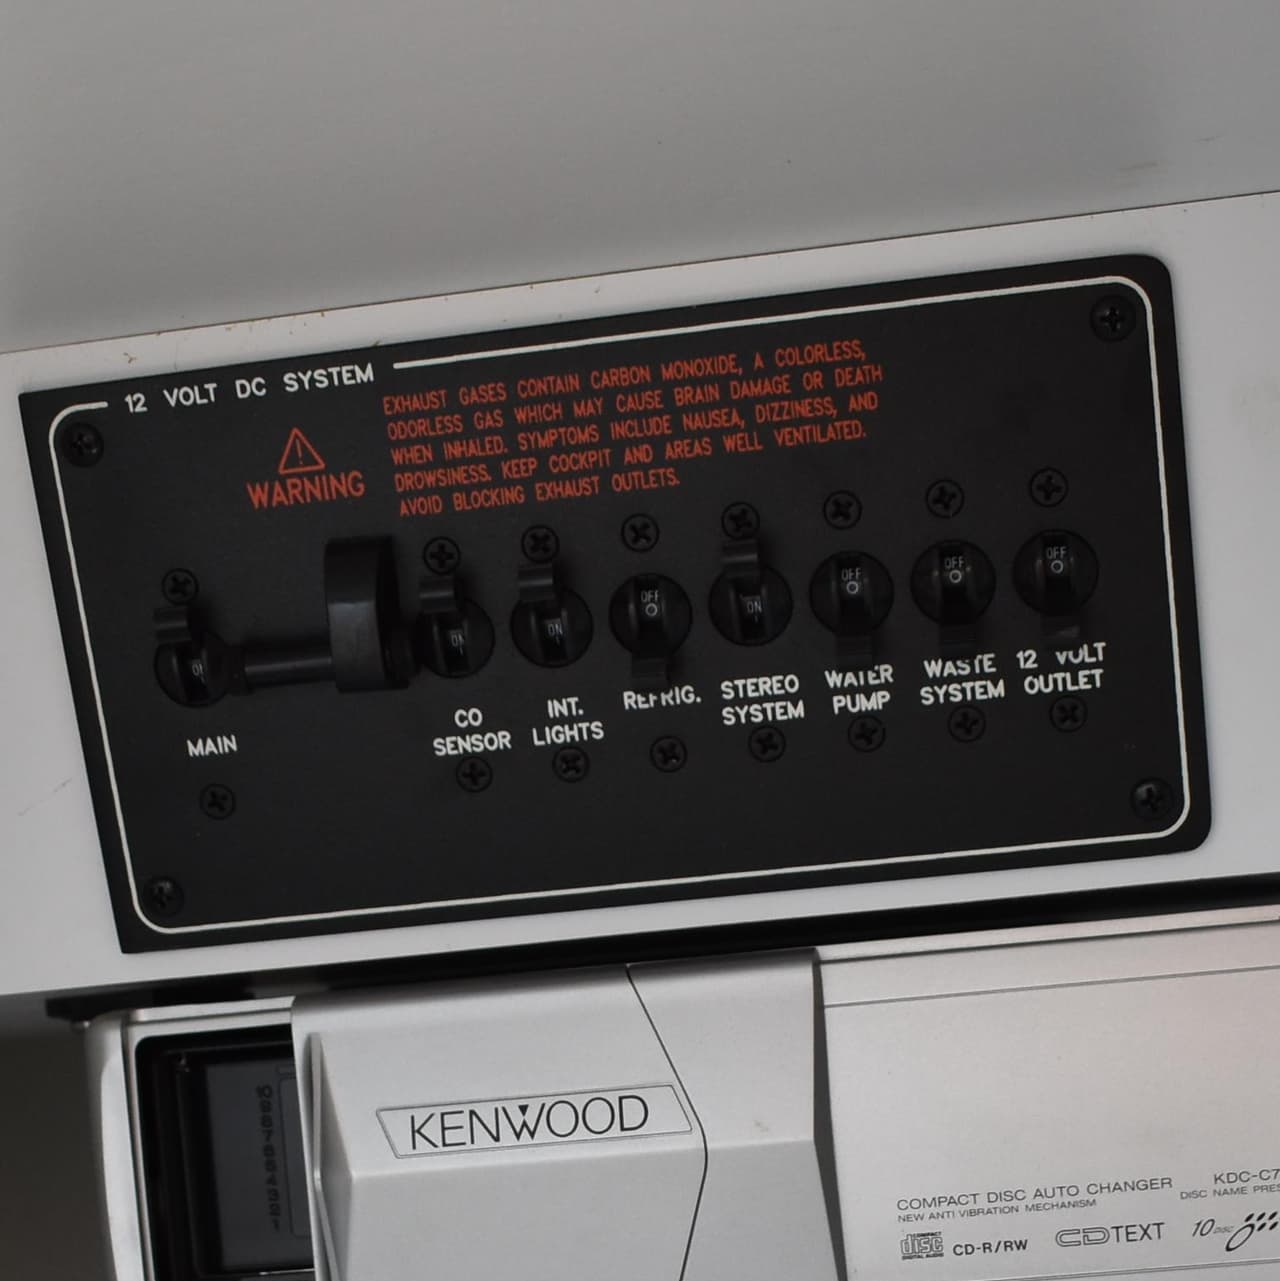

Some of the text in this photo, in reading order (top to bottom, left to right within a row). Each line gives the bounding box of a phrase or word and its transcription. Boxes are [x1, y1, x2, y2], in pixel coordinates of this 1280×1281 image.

[124, 362, 374, 412] 12 VOLT DC SYSTEM
[383, 339, 867, 416] EXHAUST GASES CONTAIN CARBON MONOXIDE, A COLORLESS,
[387, 364, 884, 440] ODORLESS GAS WHICH MAY CAUSE BRAIN DAMAGE OR DEATH
[391, 391, 879, 466] WHEN INHALED. SYMPTOMS INCLUDE NAUSEA, DIZZINESS, AND
[394, 420, 867, 493] DROWSINESS. KEEP COCKPIT AND AREAS WELL VENTILATED.
[246, 470, 366, 510] WARNING
[399, 468, 680, 518] AVOID BLOCKING EXHAUST OUTLETS.
[944, 556, 964, 570] OFF
[1046, 546, 1066, 560] OFF
[842, 568, 862, 580] OFF
[747, 600, 762, 614] ON
[548, 623, 564, 636] ON
[923, 653, 997, 679] WASTE
[1016, 649, 1038, 669] 12
[720, 674, 800, 700] STEREO
[824, 664, 894, 688] WATER
[1024, 668, 1104, 694] OUTLET
[832, 690, 890, 715] PUMP
[920, 678, 1006, 706] SYSTEM
[454, 707, 483, 728] CO
[546, 696, 584, 718] INT.
[722, 700, 805, 726] SYSTEM
[186, 734, 238, 756] MAIN
[432, 730, 512, 756] SENSOR
[532, 721, 604, 746] LIGHTS
[410, 1094, 649, 1152] KENWOOD
[897, 1177, 1173, 1211] COMPACT DISC AUTO CHANGER
[1180, 1190, 1207, 1200] DISC
[1213, 1186, 1248, 1197] NAME
[898, 1199, 1097, 1223] NEW ANTI VIBRATION MECHANISM
[1192, 1218, 1216, 1236] 10
[952, 1238, 1028, 1256] CD-R/RW
